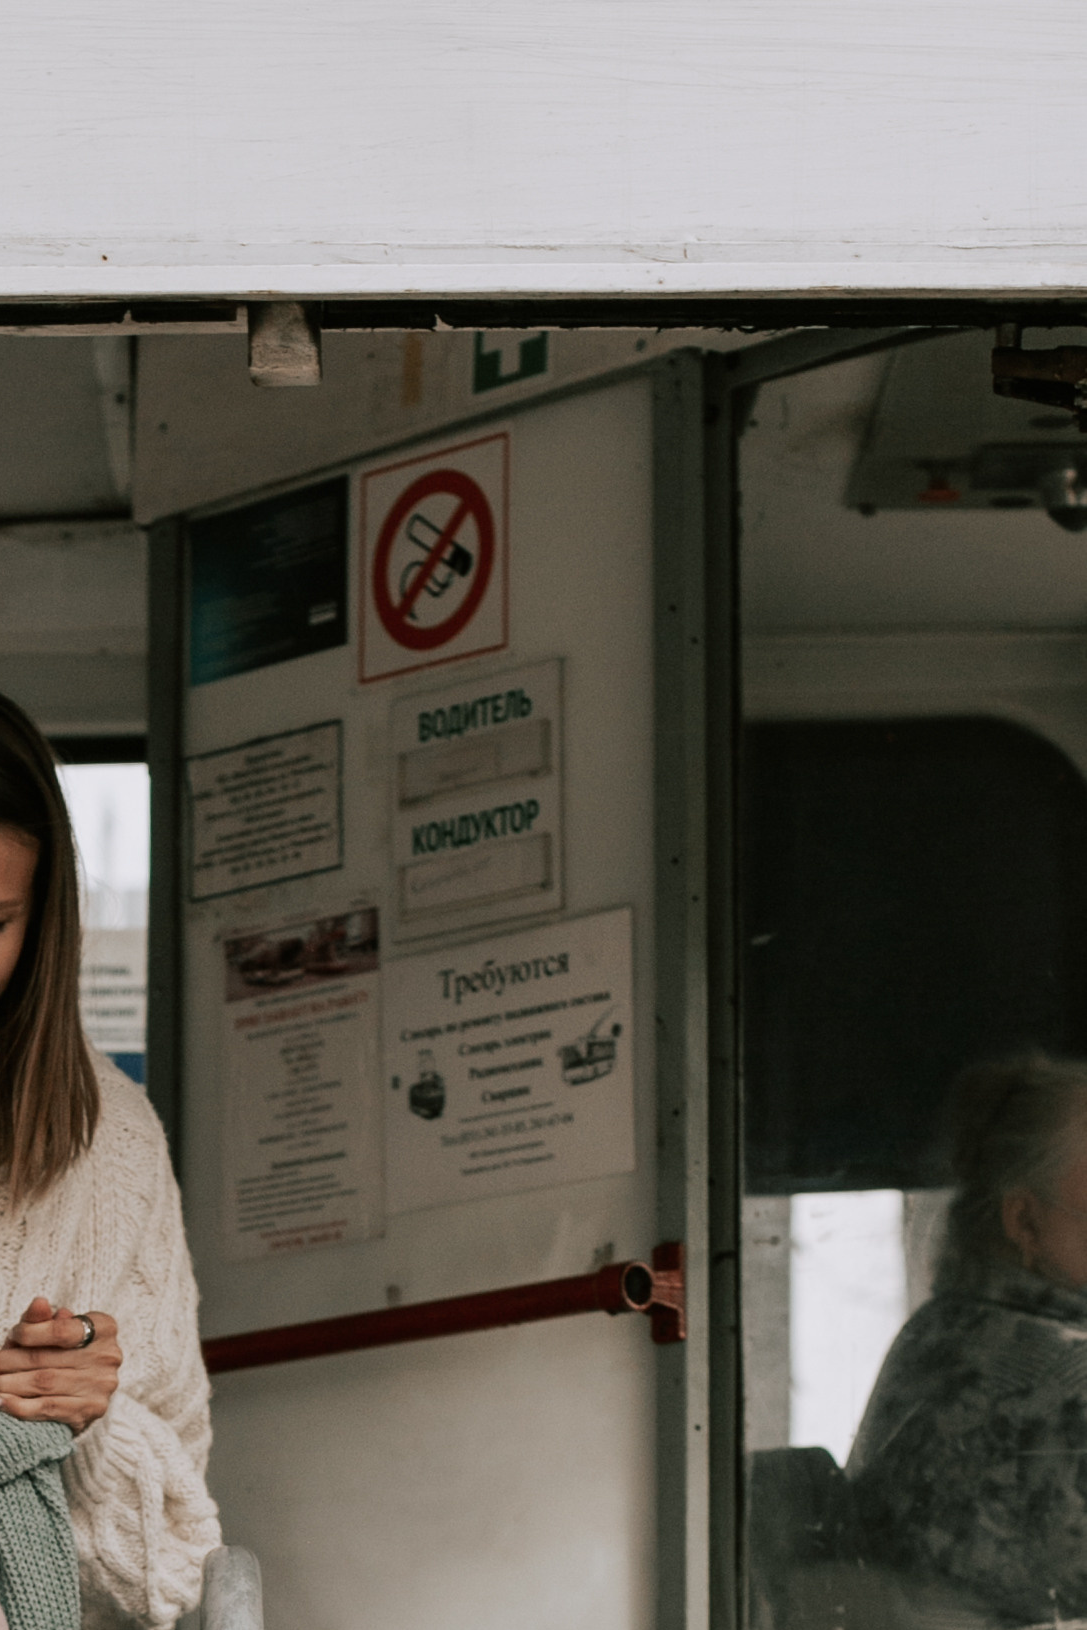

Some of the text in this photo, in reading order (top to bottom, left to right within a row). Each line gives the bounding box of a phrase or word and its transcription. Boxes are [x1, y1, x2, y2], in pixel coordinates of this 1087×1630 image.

[418, 688, 533, 743] ВОДИТЕЛЬ
[411, 799, 540, 855] КОНДУКТОР
[438, 953, 569, 1004] Требуются
